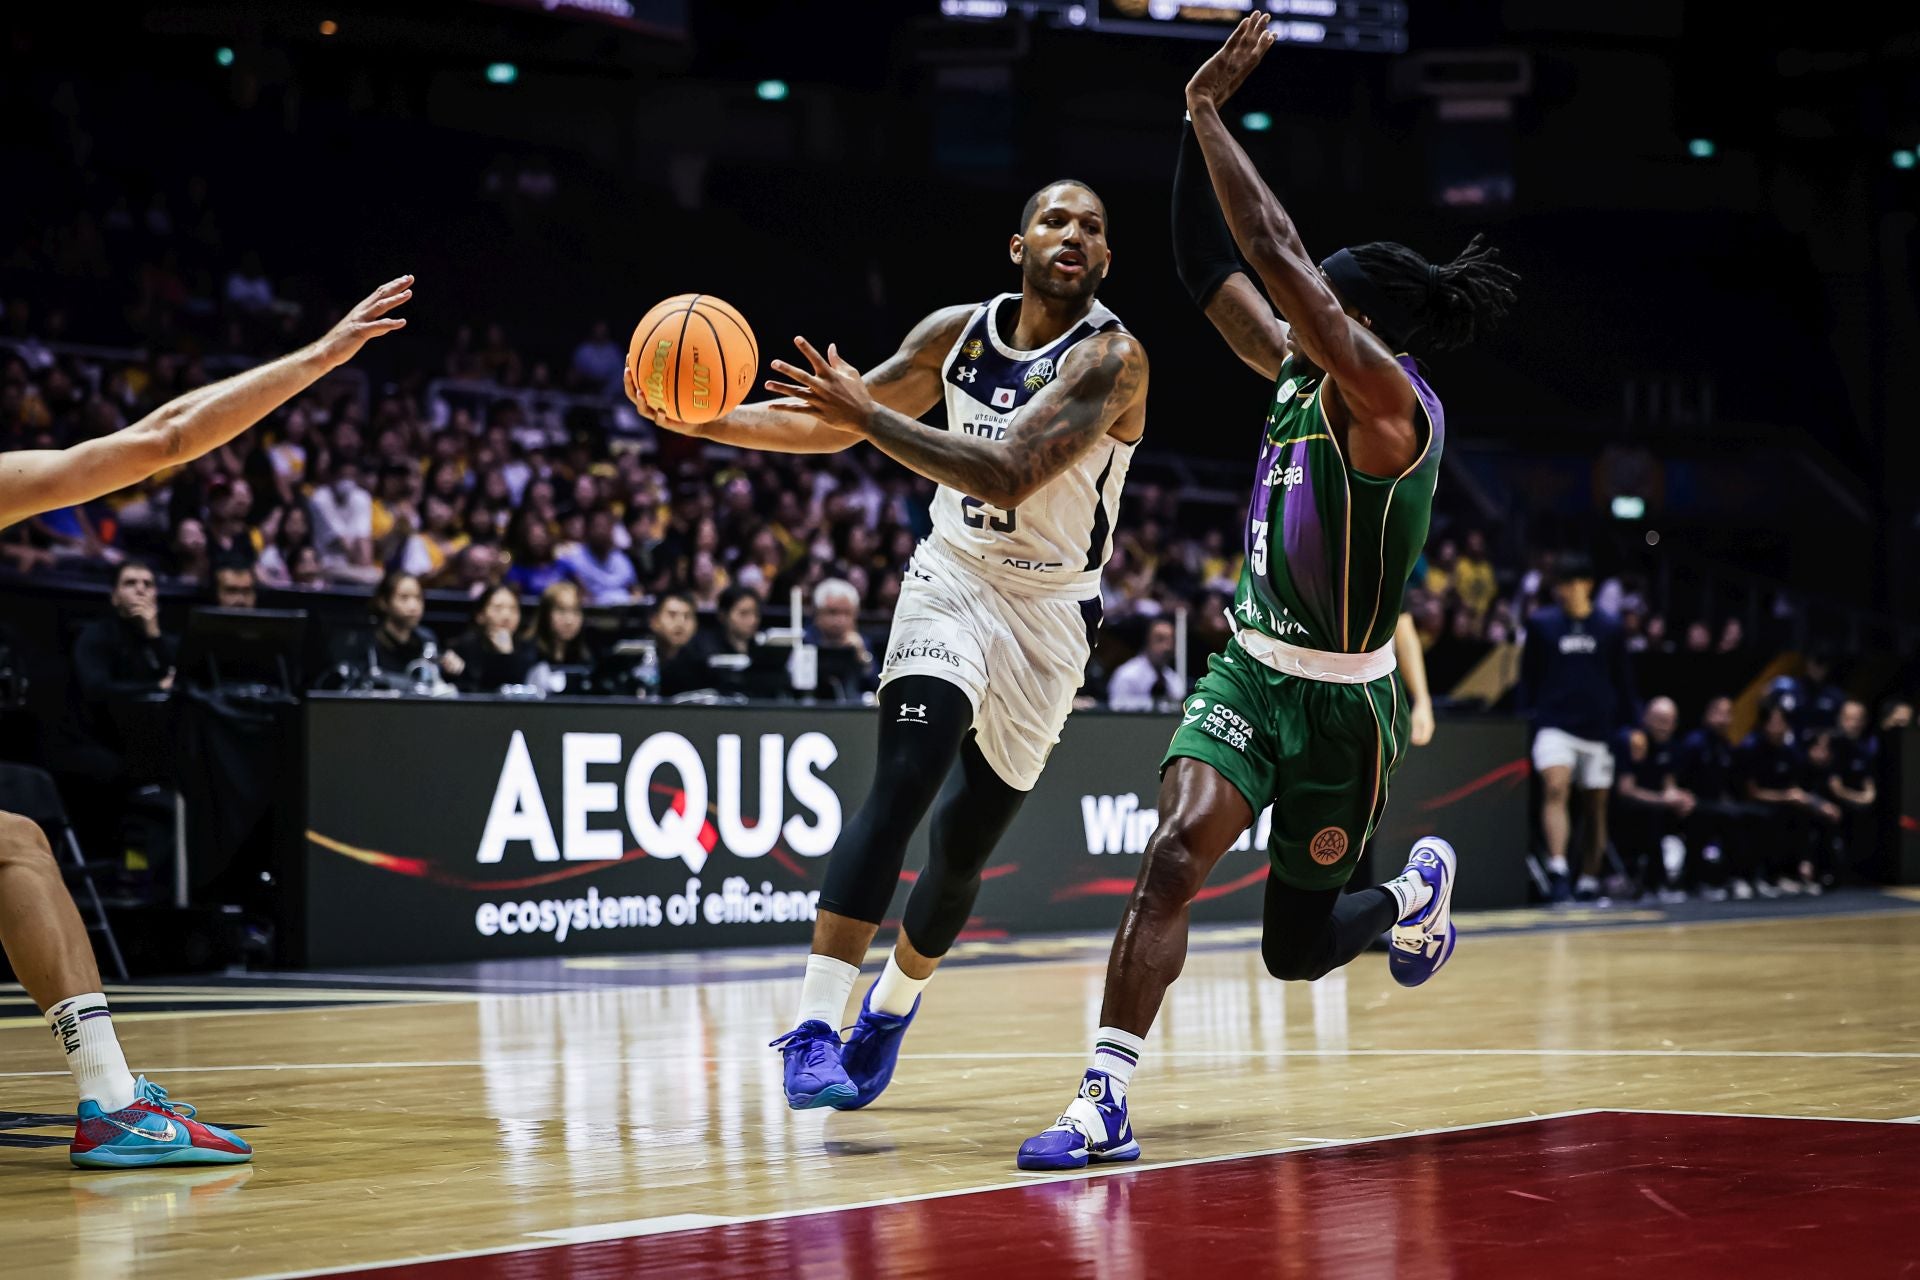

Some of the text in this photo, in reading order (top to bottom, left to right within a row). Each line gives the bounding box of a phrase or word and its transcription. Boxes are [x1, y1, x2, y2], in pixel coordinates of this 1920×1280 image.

[1206, 712, 1247, 744] DEL SOL
[1213, 704, 1254, 739] COSTA
[476, 730, 842, 873] AEQUS
[1080, 792, 1160, 855] Win
[476, 876, 820, 943] ecosystems of efficienc
